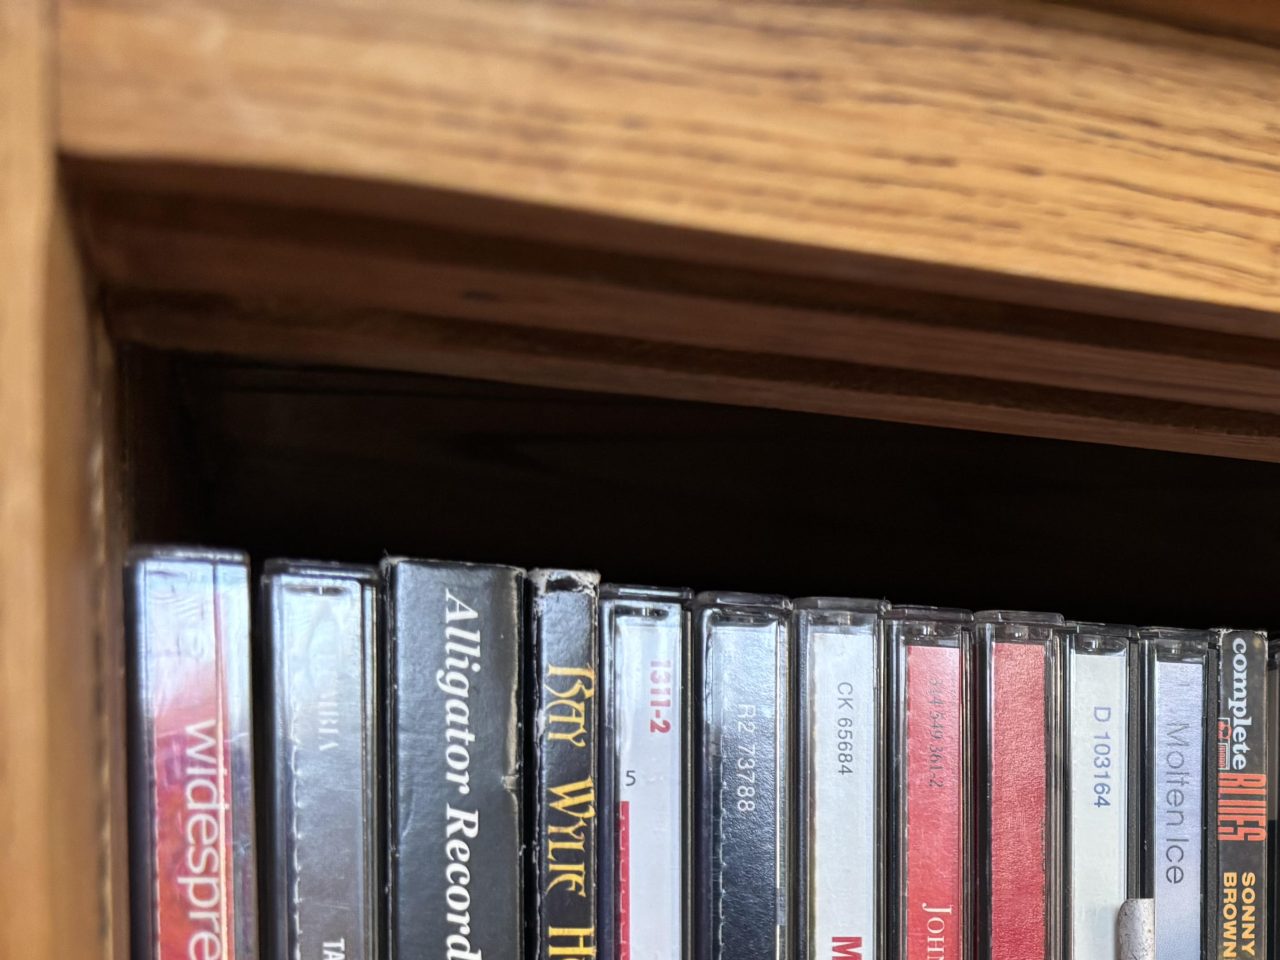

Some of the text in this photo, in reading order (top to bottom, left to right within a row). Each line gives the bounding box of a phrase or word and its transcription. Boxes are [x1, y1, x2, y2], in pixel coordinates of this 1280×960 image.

[437, 588, 482, 794] Alligator
[545, 664, 597, 748] RAY
[649, 658, 673, 734] 1311-2
[836, 681, 854, 776] CK 65684
[1227, 637, 1252, 771] complete
[736, 703, 756, 813] R2 73788
[927, 743, 944, 789] 361-2
[1093, 706, 1111, 809] D 103164
[1164, 722, 1192, 827] Molten
[545, 776, 596, 898] WYLIE
[1218, 773, 1267, 842] BLUES
[1165, 837, 1190, 885] Ice
[1239, 872, 1256, 957] SONNY
